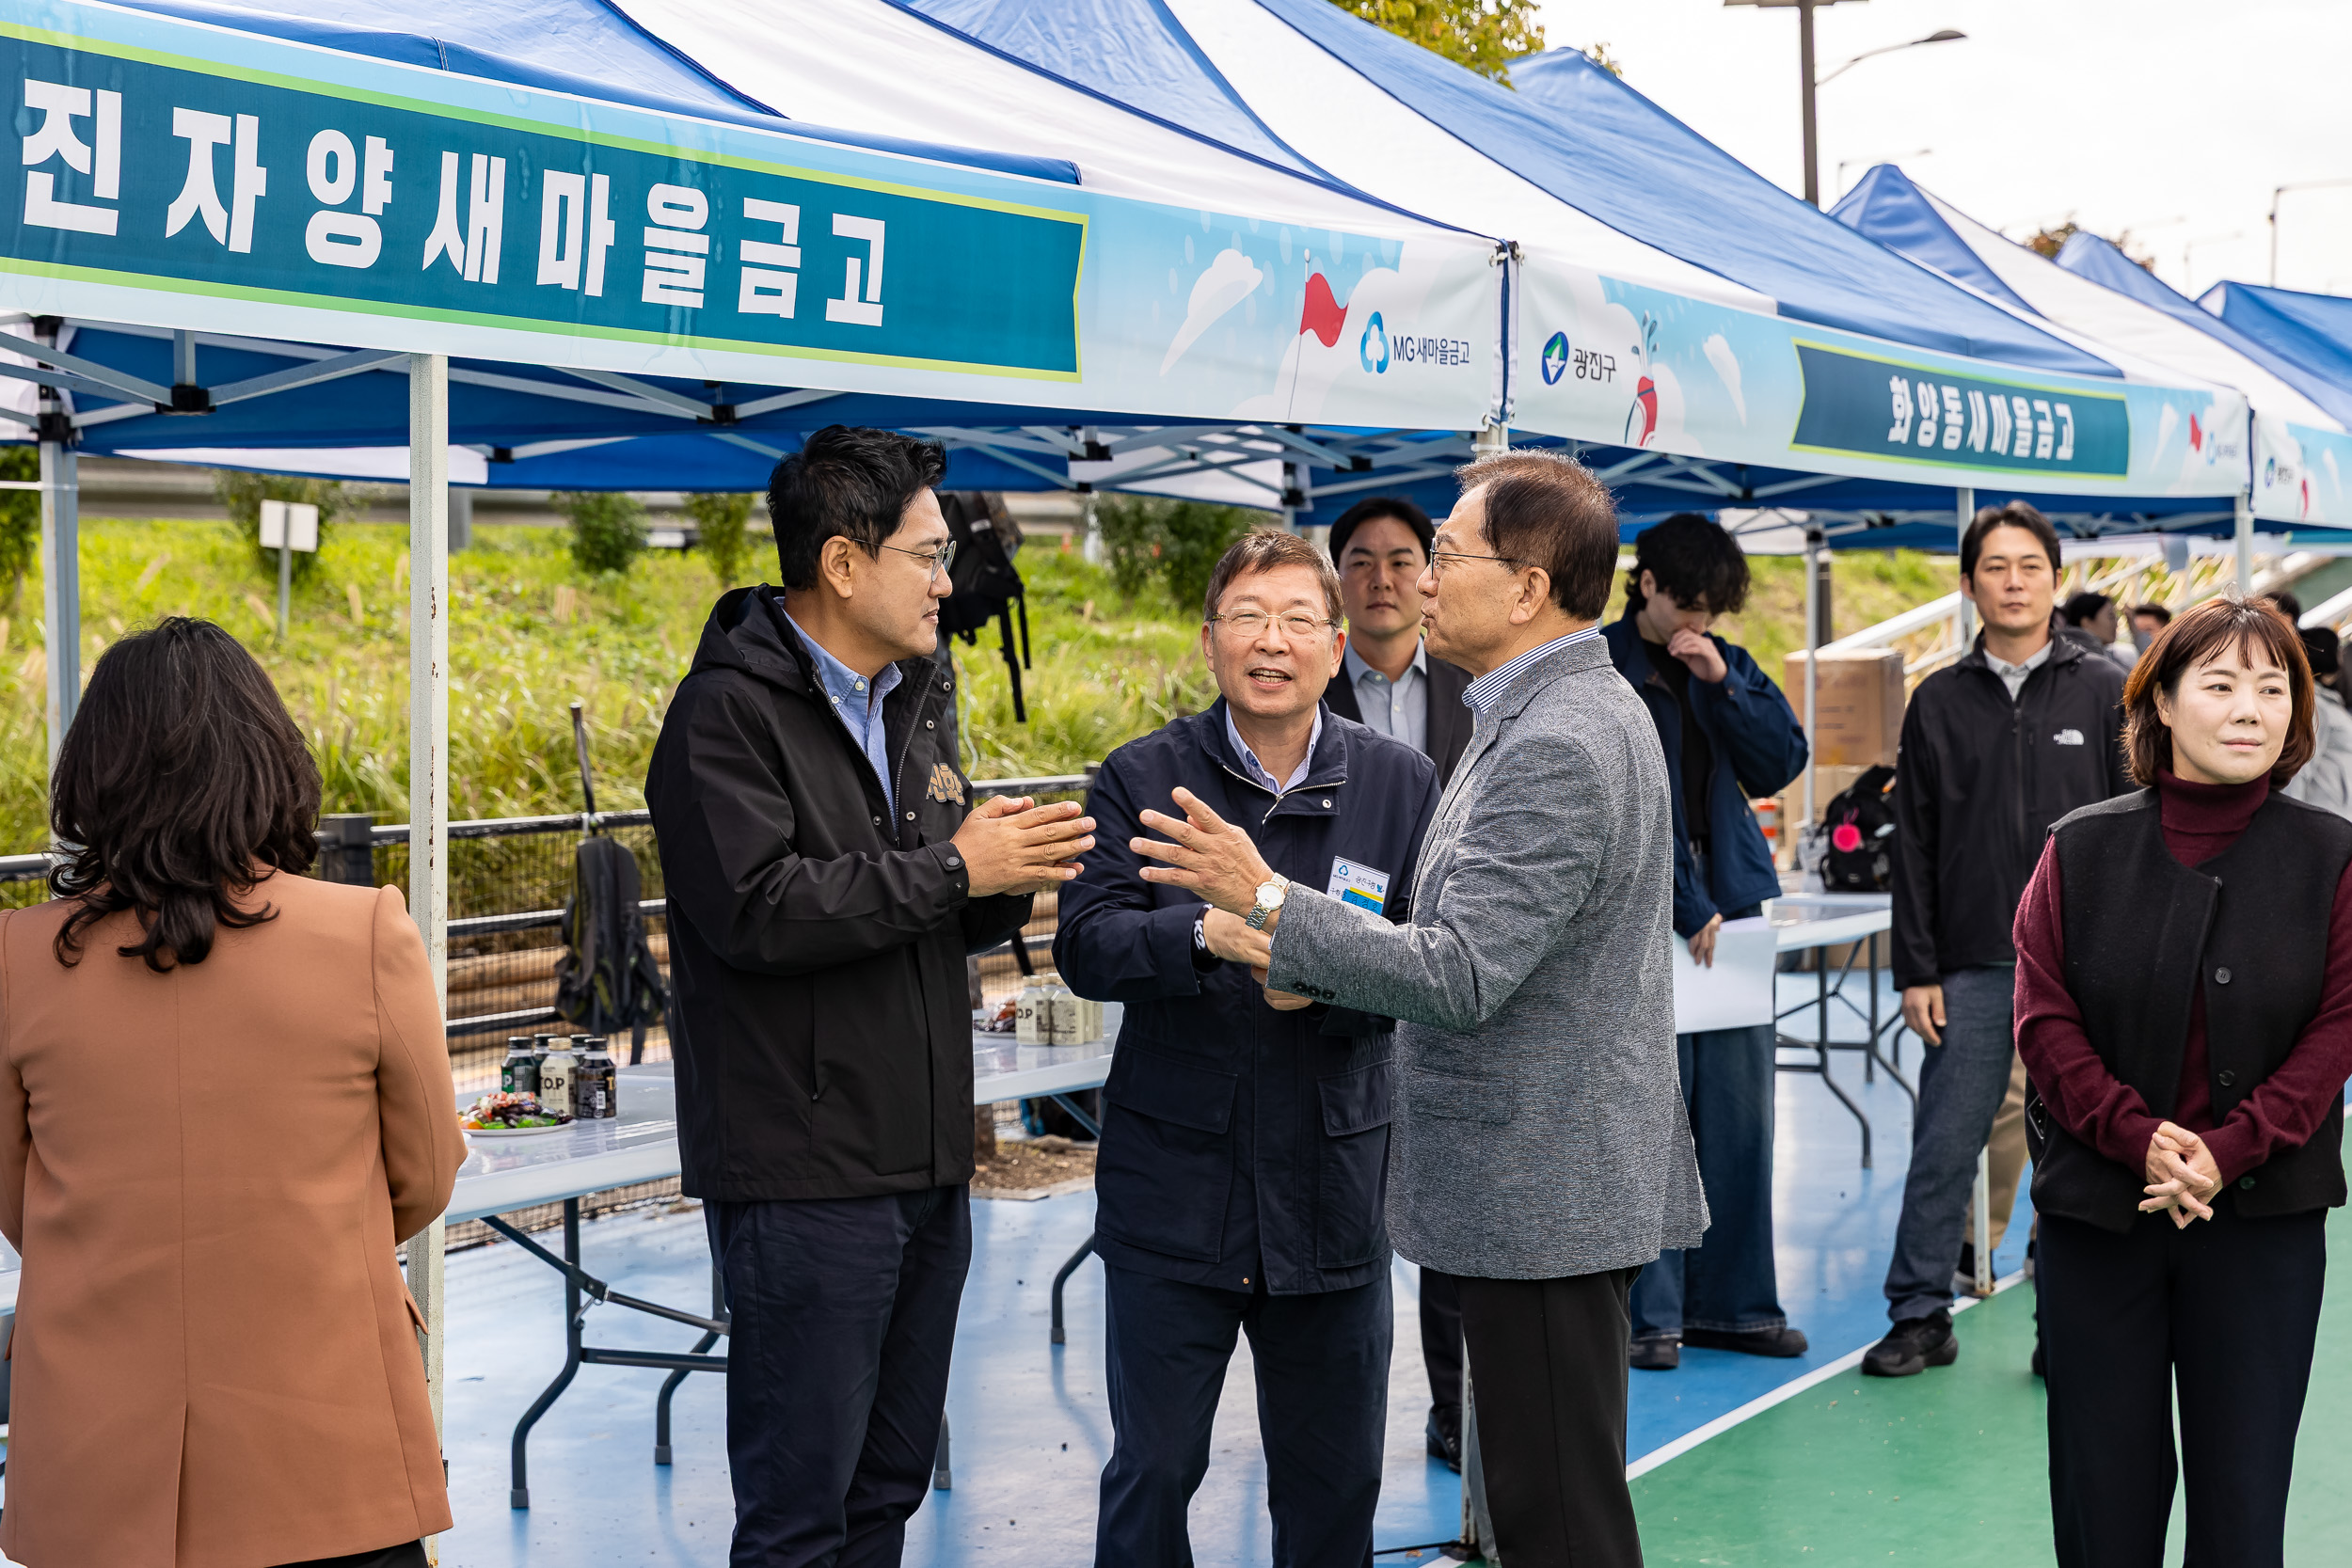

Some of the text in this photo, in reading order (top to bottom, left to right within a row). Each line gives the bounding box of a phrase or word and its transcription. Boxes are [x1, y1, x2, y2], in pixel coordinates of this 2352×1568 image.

[23, 78, 886, 328] 진자양새마을금고
[1392, 334, 1470, 367] MG새마을금고
[1573, 346, 1617, 384] 광진구
[1887, 375, 2075, 461] 화양동새마을금고
